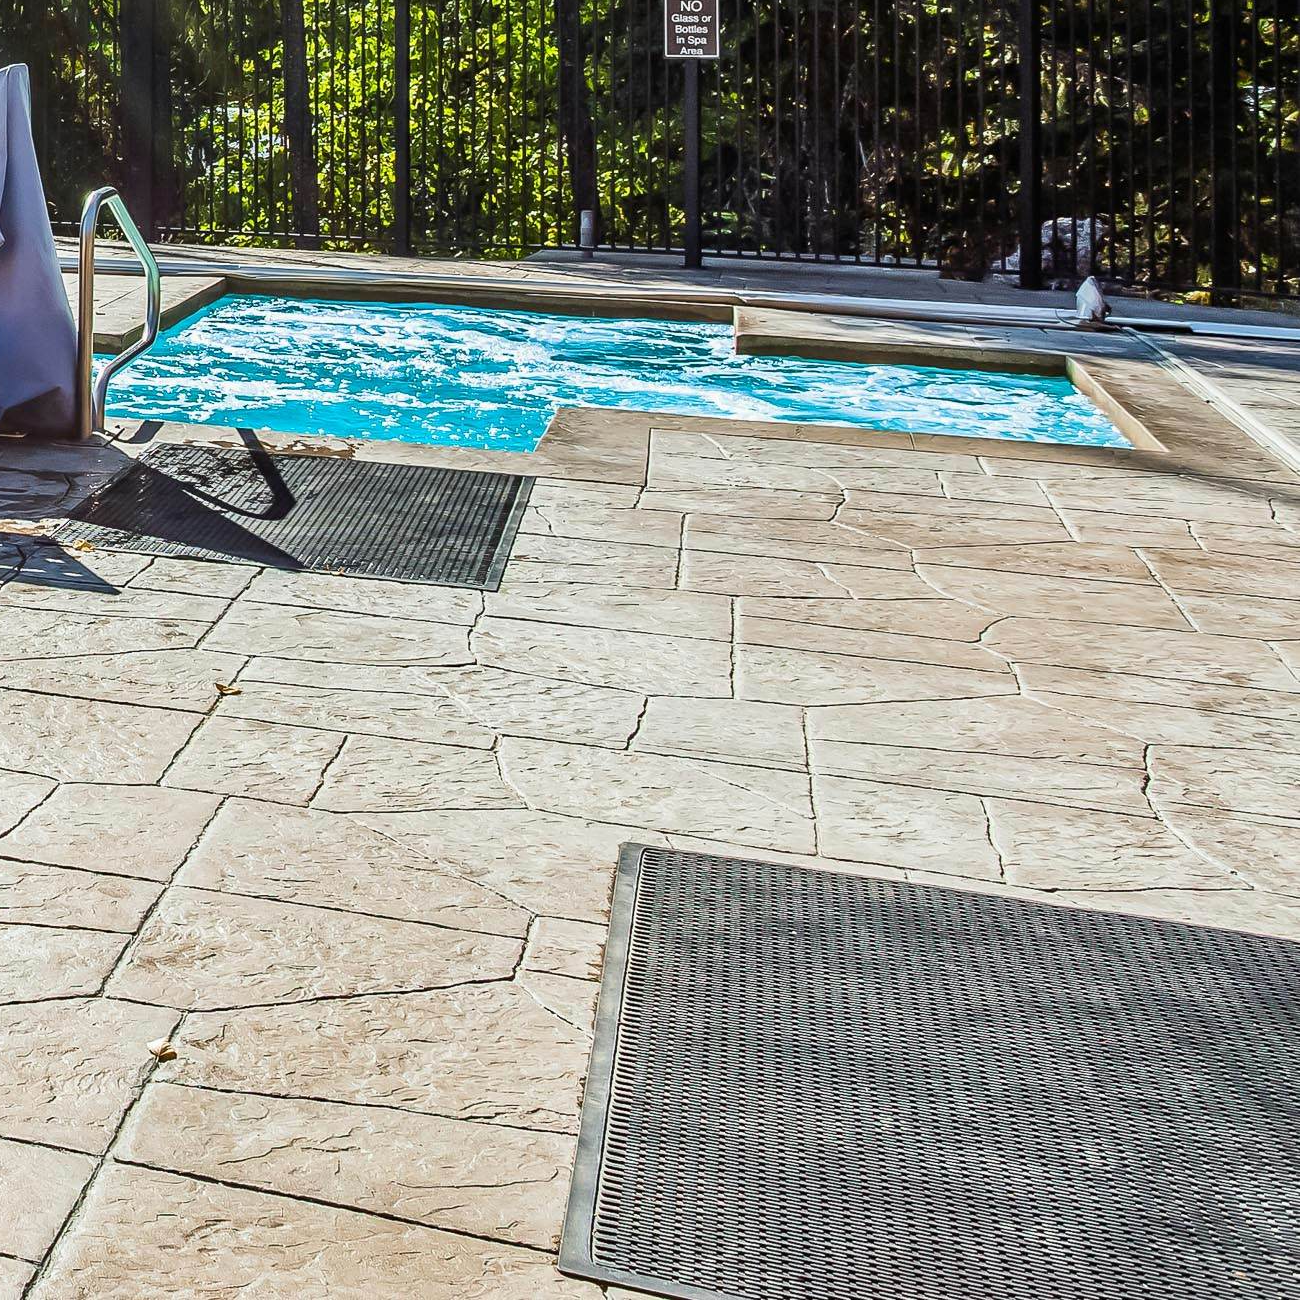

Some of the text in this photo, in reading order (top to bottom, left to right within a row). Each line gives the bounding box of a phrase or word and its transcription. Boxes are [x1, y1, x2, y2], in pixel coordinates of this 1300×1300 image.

[680, 1, 702, 12] NO
[671, 14, 712, 23] Glass or
[675, 25, 708, 34] Bottles
[676, 36, 707, 46] in Spa
[680, 47, 703, 55] Area
